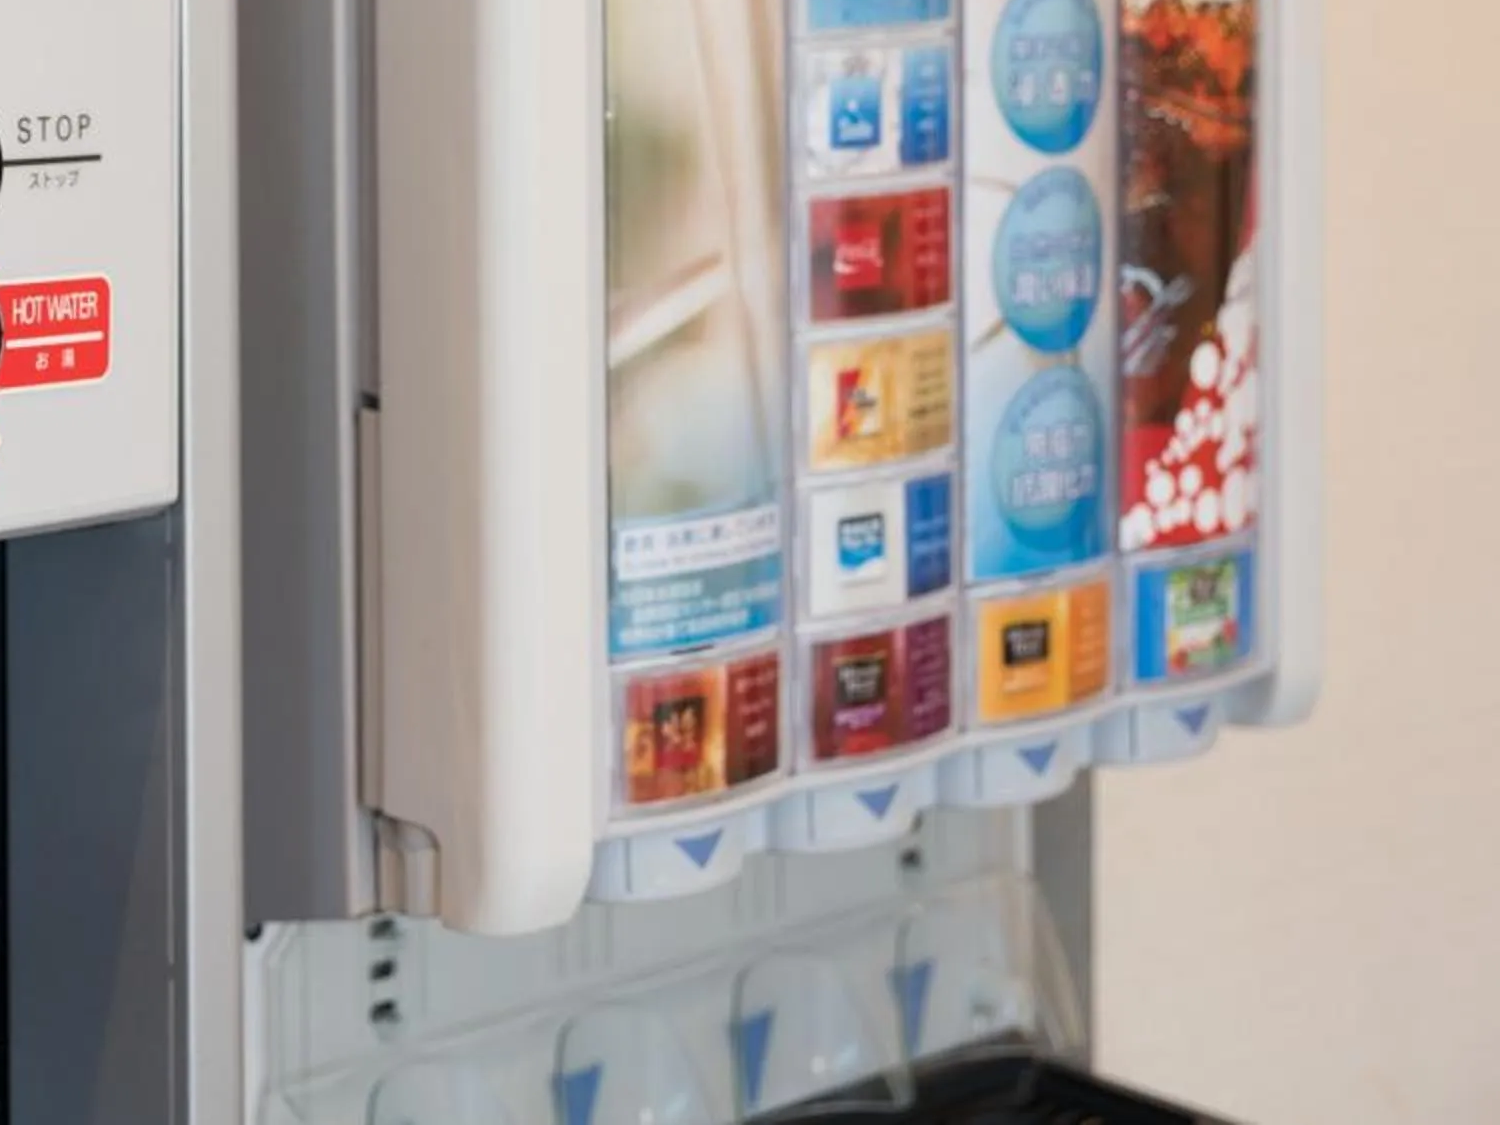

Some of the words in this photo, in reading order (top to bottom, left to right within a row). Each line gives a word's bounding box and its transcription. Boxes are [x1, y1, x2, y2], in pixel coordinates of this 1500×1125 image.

[16, 113, 93, 145] STOP
[28, 170, 81, 190] ストップ
[11, 295, 48, 327] HOT
[46, 291, 99, 324] WATER
